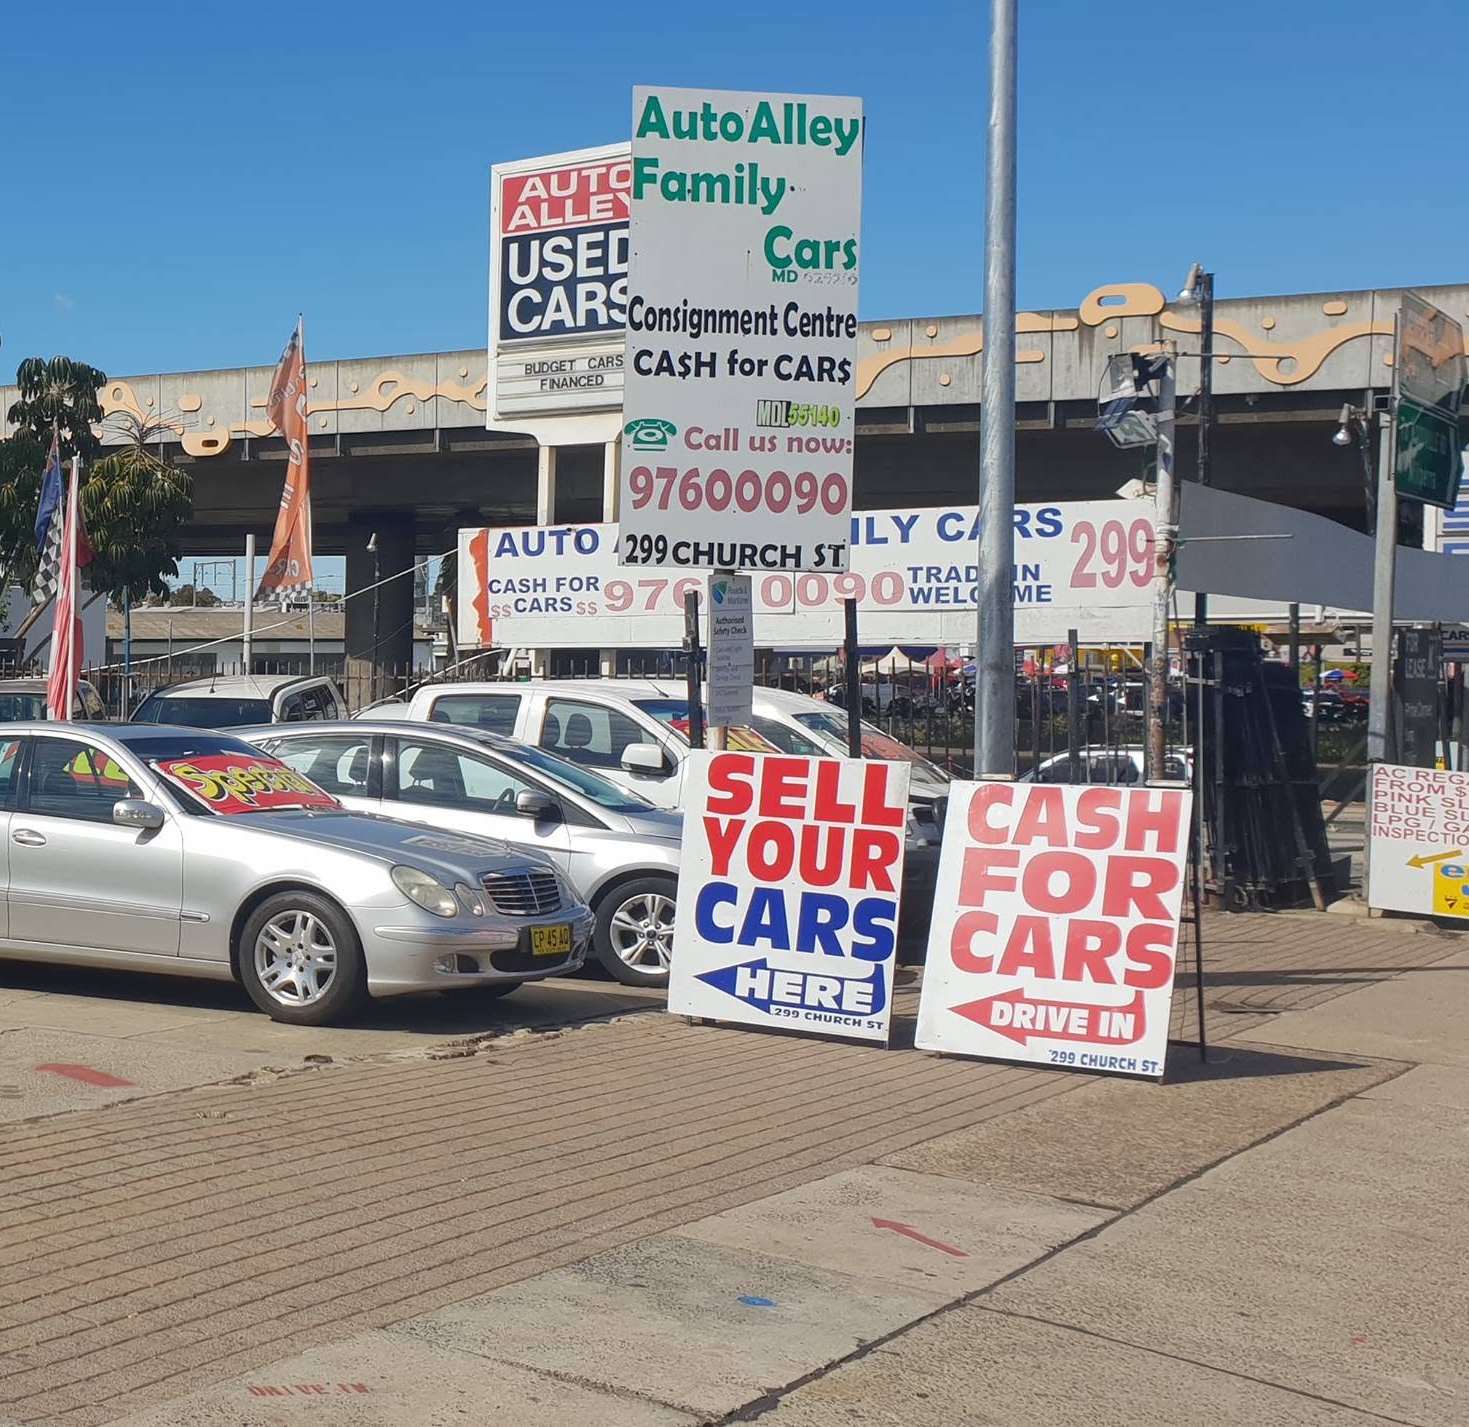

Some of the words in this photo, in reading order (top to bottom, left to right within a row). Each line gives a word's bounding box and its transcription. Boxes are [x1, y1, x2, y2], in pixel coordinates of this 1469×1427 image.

[518, 164, 630, 203] AUTO
[633, 158, 785, 215] Family
[764, 226, 857, 269] Cars
[772, 270, 798, 283] MD
[628, 296, 778, 338] Consignment
[783, 302, 857, 338] Centre
[525, 360, 576, 374] BUDGET
[588, 355, 623, 369] CARS
[633, 349, 717, 379] CA$H
[727, 349, 768, 377] for
[774, 355, 852, 385] CAR$
[540, 375, 604, 390] FINANCED
[684, 427, 739, 451] Call
[749, 435, 777, 452] us
[788, 437, 852, 454] now:
[630, 467, 848, 516] 97600090
[494, 527, 599, 558] AUTO
[625, 534, 668, 565] 299
[672, 541, 802, 568] CHURCH
[1070, 519, 1155, 588] 299
[488, 578, 547, 594] CASH
[555, 576, 600, 593] FOR
[907, 565, 979, 584] TRAD
[1011, 564, 1040, 581] IN
[491, 604, 511, 618] $$
[514, 596, 572, 613] CARS
[576, 601, 598, 616] $$
[908, 585, 1052, 604] WELME
[713, 626, 730, 637] Safety
[731, 626, 747, 635] Check
[169, 763, 322, 807] Special
[1375, 767, 1406, 779] AC
[1375, 778, 1445, 795] FROM
[706, 753, 904, 827] SELL
[1374, 790, 1432, 806] PINK
[967, 783, 1182, 853] CASH
[1374, 802, 1436, 818] BLUE
[1374, 814, 1421, 828] LPG
[703, 816, 900, 893] YOUR
[957, 846, 1180, 921] FOR
[695, 881, 896, 962] CARS
[950, 910, 1175, 990] CARS
[734, 966, 874, 1014] HERE
[774, 1008, 799, 1018] 299
[804, 1012, 862, 1028] CHURCH
[990, 1000, 1089, 1035] DRIVE
[1098, 1011, 1135, 1040] IN
[1050, 1050, 1075, 1064] 299
[1080, 1054, 1137, 1071] CHURCH
